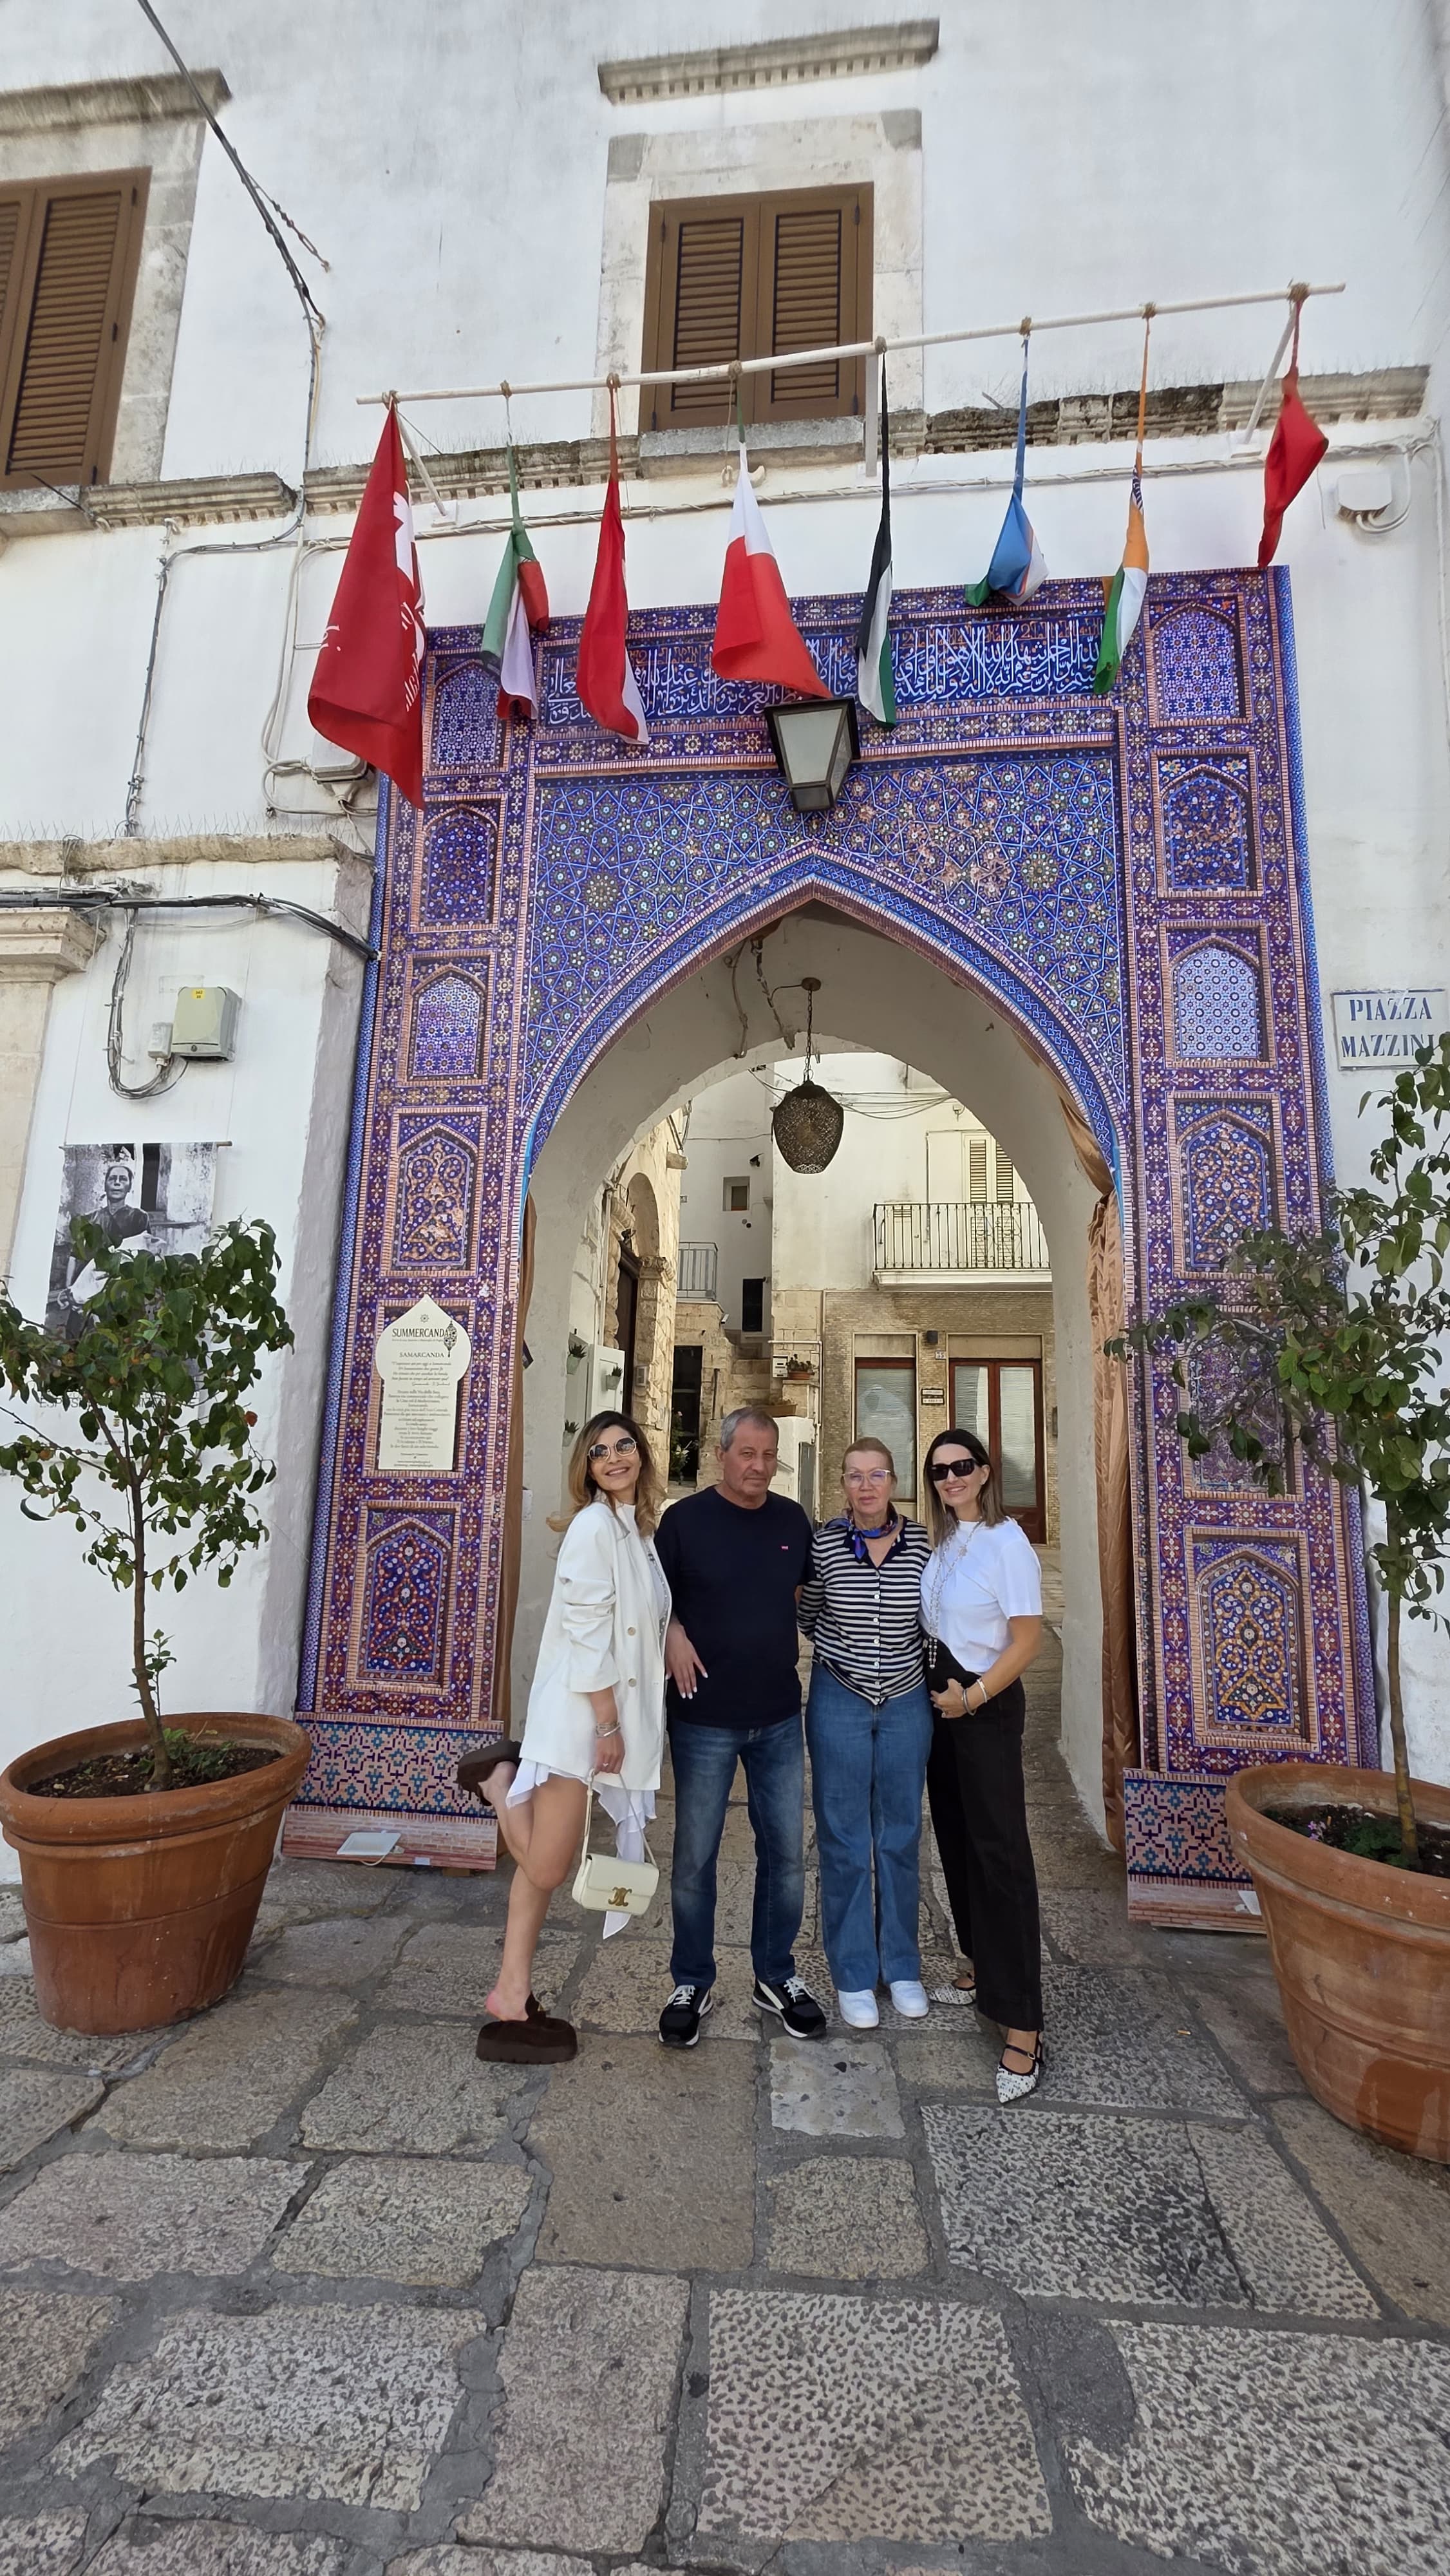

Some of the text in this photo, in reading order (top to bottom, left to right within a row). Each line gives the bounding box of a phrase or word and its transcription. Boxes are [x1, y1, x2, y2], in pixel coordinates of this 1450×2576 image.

[1350, 998, 1432, 1021] PIAZZA
[1341, 1034, 1435, 1057] MAZZINI
[392, 1329, 449, 1337] SUMMERCANDA
